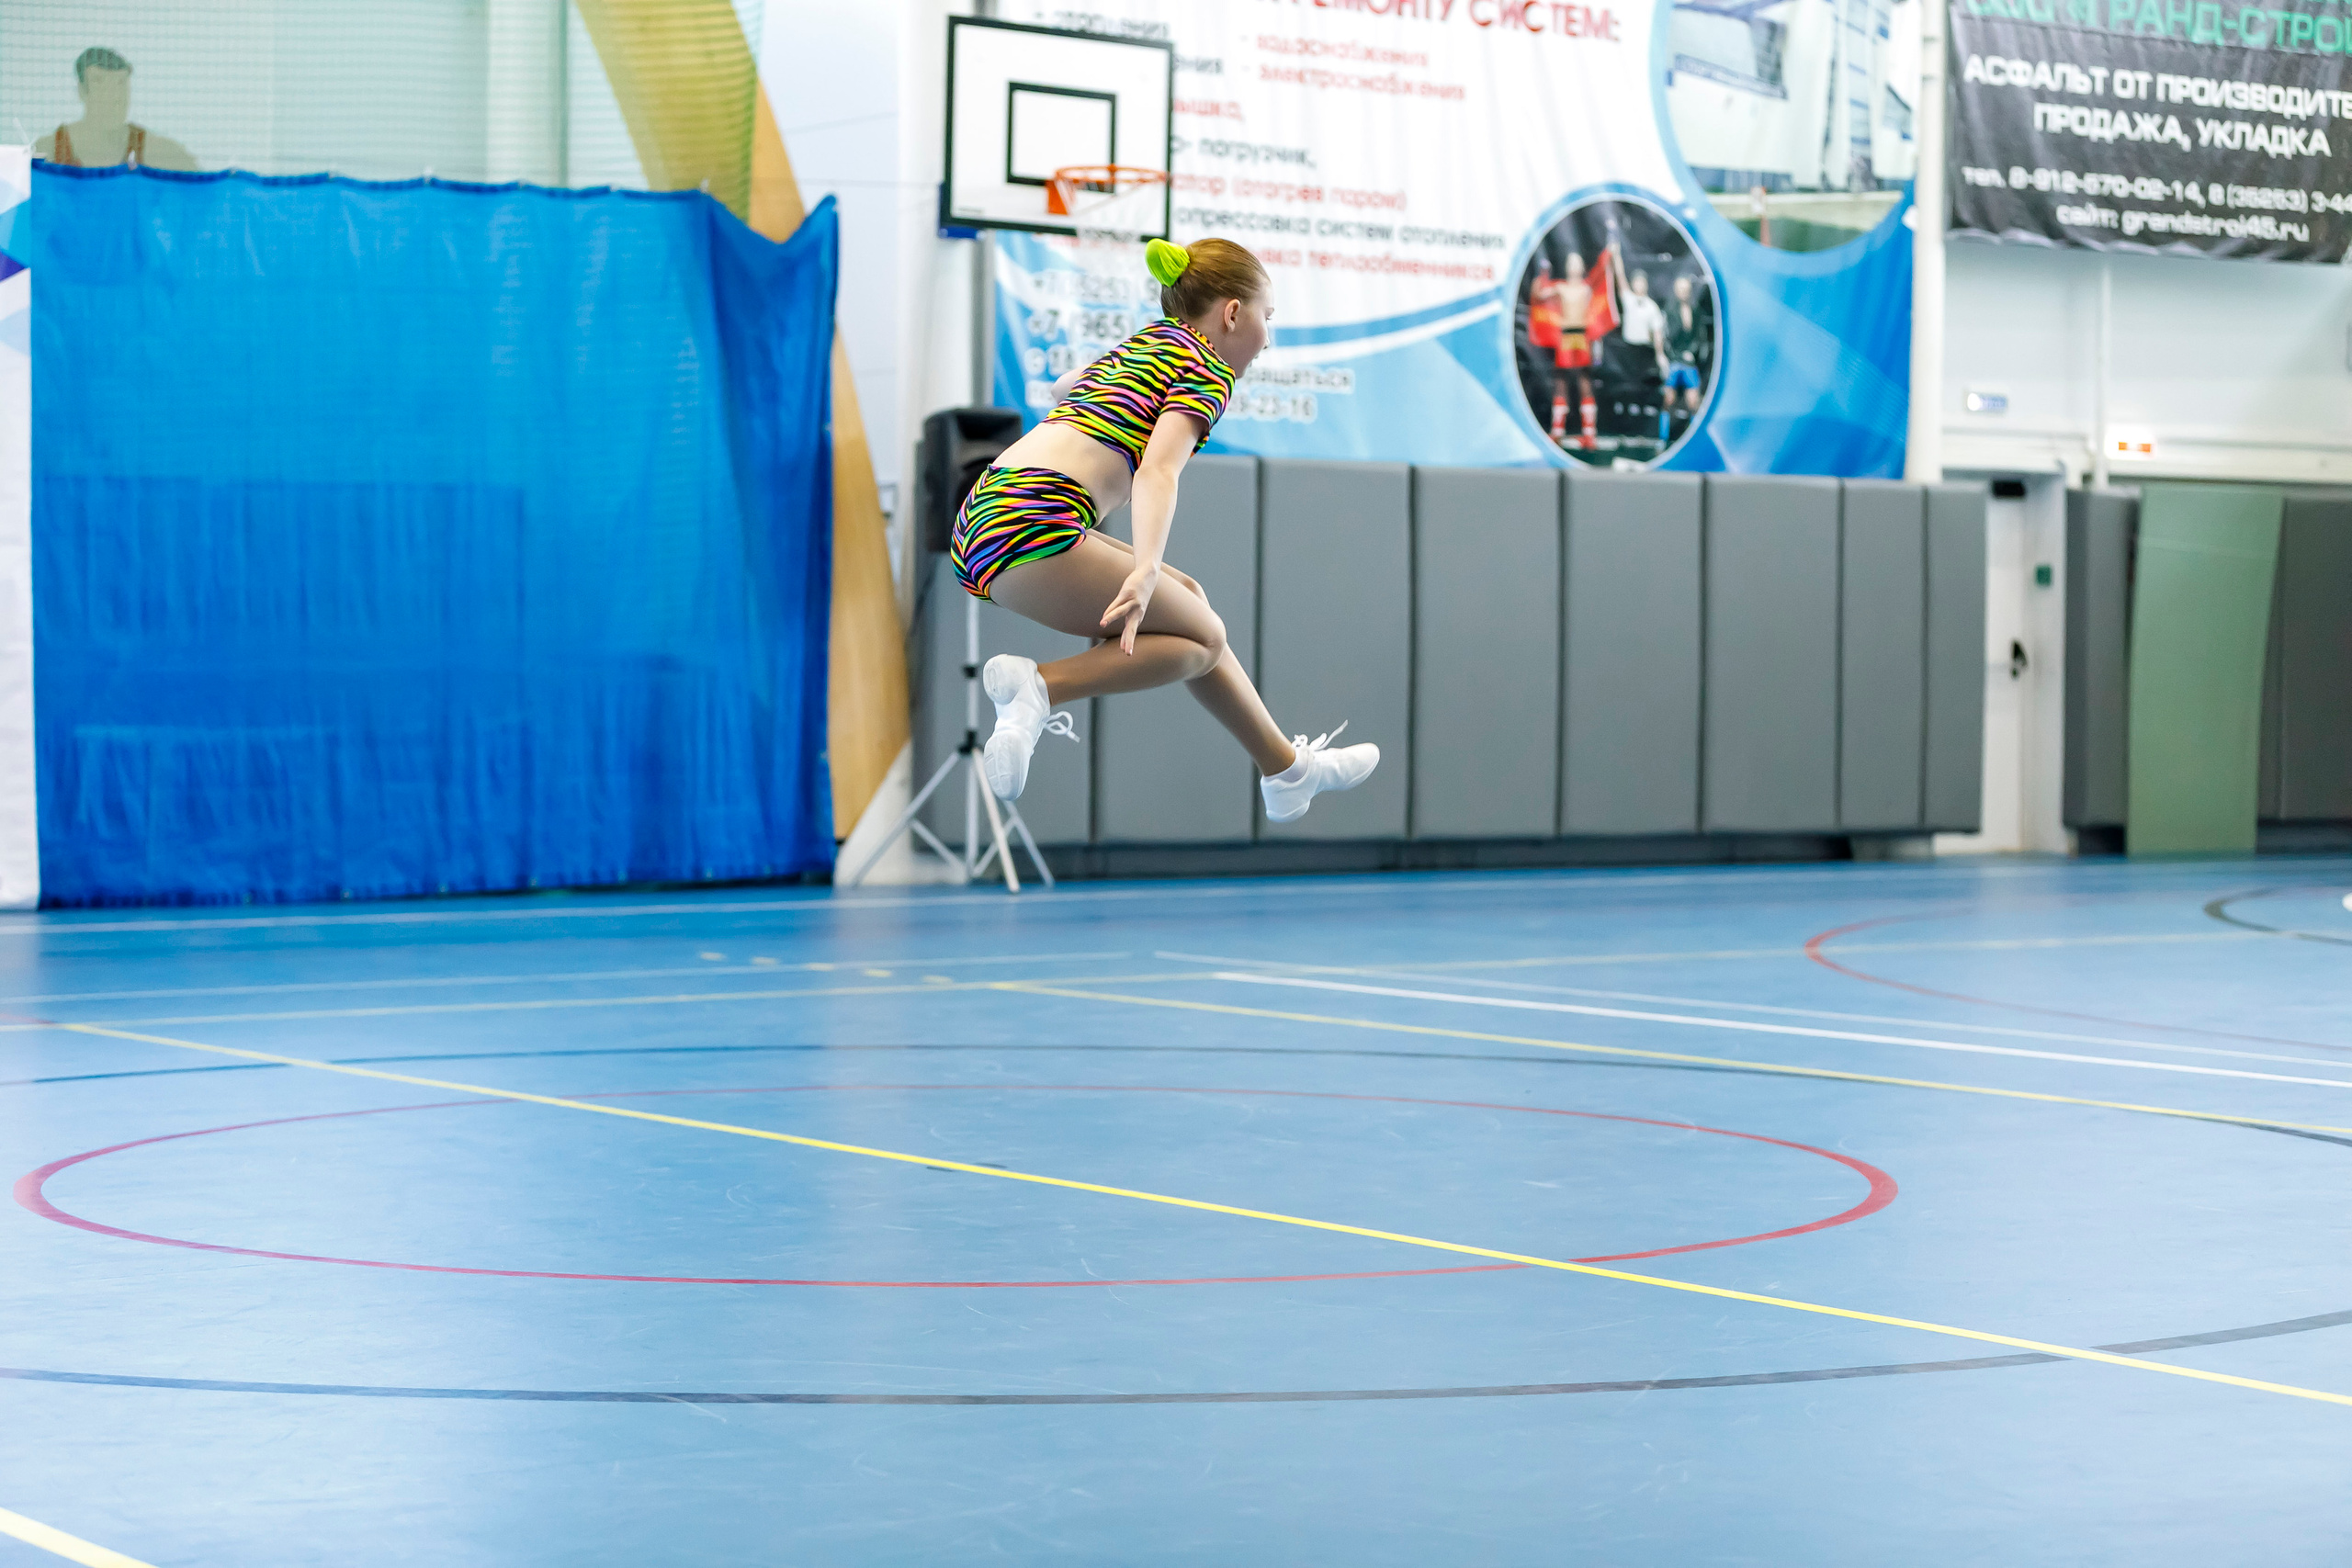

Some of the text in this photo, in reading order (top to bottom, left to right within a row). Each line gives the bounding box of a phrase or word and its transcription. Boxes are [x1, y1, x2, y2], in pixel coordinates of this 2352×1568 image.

[1469, 0, 1621, 42] СИСТЕМ:
[1963, 53, 2110, 96] АСФАЛЬТ
[2113, 69, 2153, 100] ОТ
[2033, 102, 2333, 160] ПРОДАЖА, УКЛАДКА
